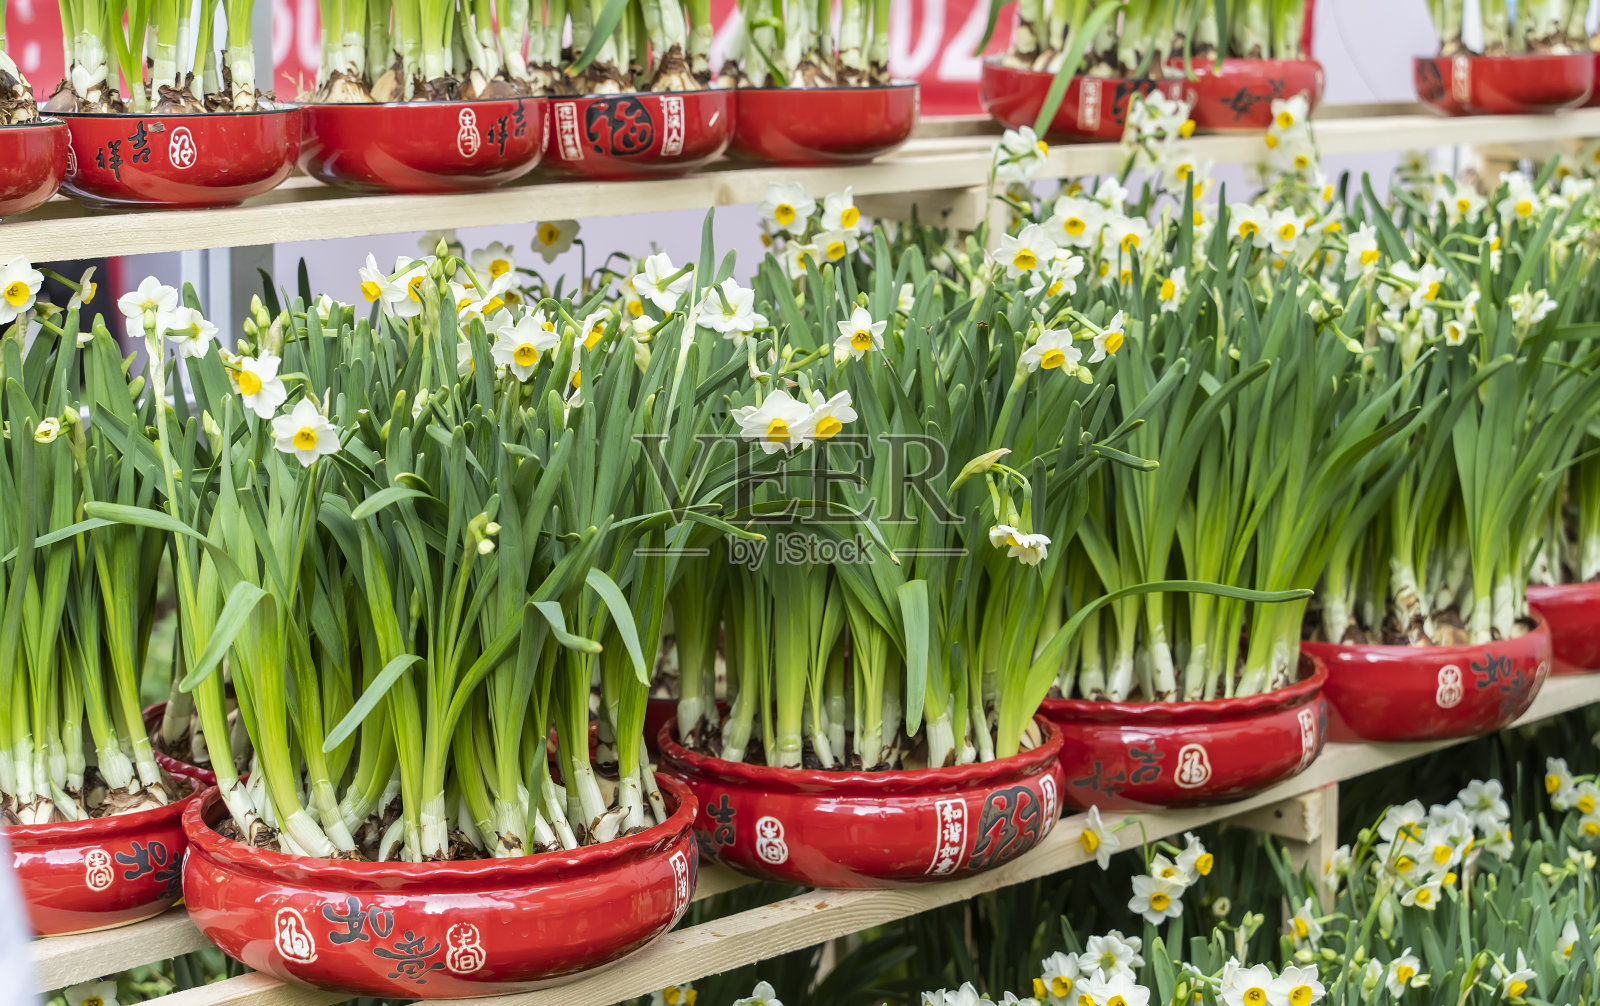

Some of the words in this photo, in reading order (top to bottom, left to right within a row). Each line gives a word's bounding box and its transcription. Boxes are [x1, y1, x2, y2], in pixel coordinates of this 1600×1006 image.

[557, 104, 582, 158] 花开富
[584, 97, 654, 157] 福
[931, 801, 964, 875] 和谐如意
[322, 896, 446, 985] 如意
